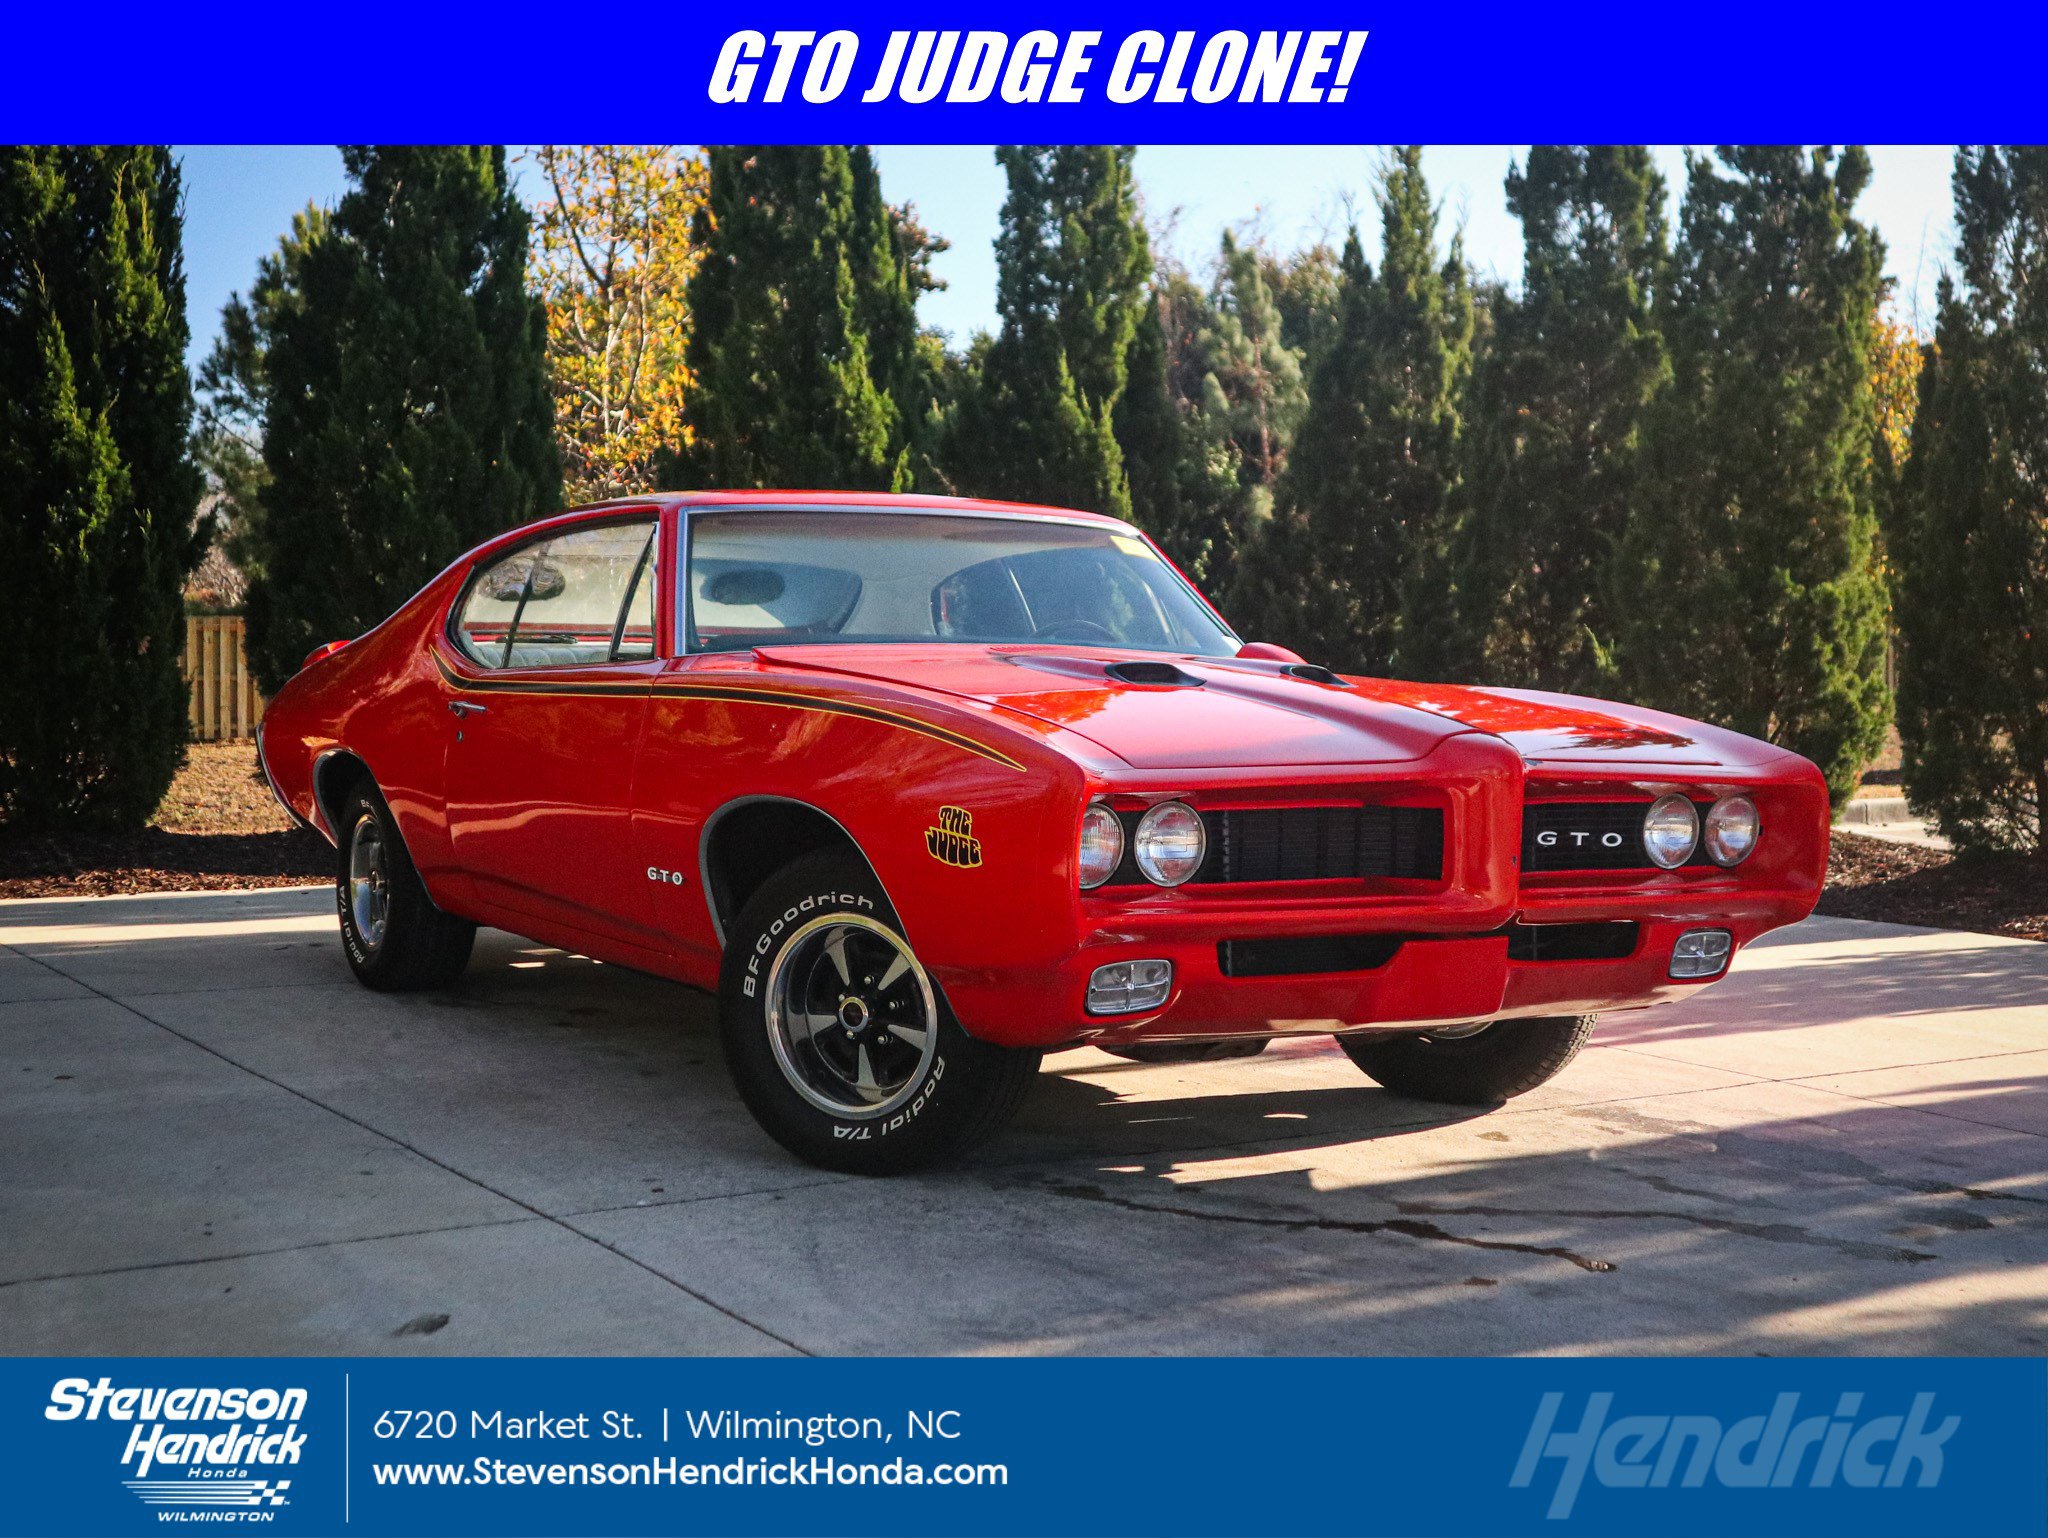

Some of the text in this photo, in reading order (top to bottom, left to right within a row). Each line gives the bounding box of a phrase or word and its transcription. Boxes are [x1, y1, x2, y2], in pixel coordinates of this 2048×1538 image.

[939, 805, 973, 838] THE
[1537, 831, 1622, 847] GTO
[924, 826, 983, 868] JUDGE
[647, 866, 682, 885] GTO
[743, 891, 874, 998] BFGoodrich
[833, 1056, 946, 1140] Radial T/A
